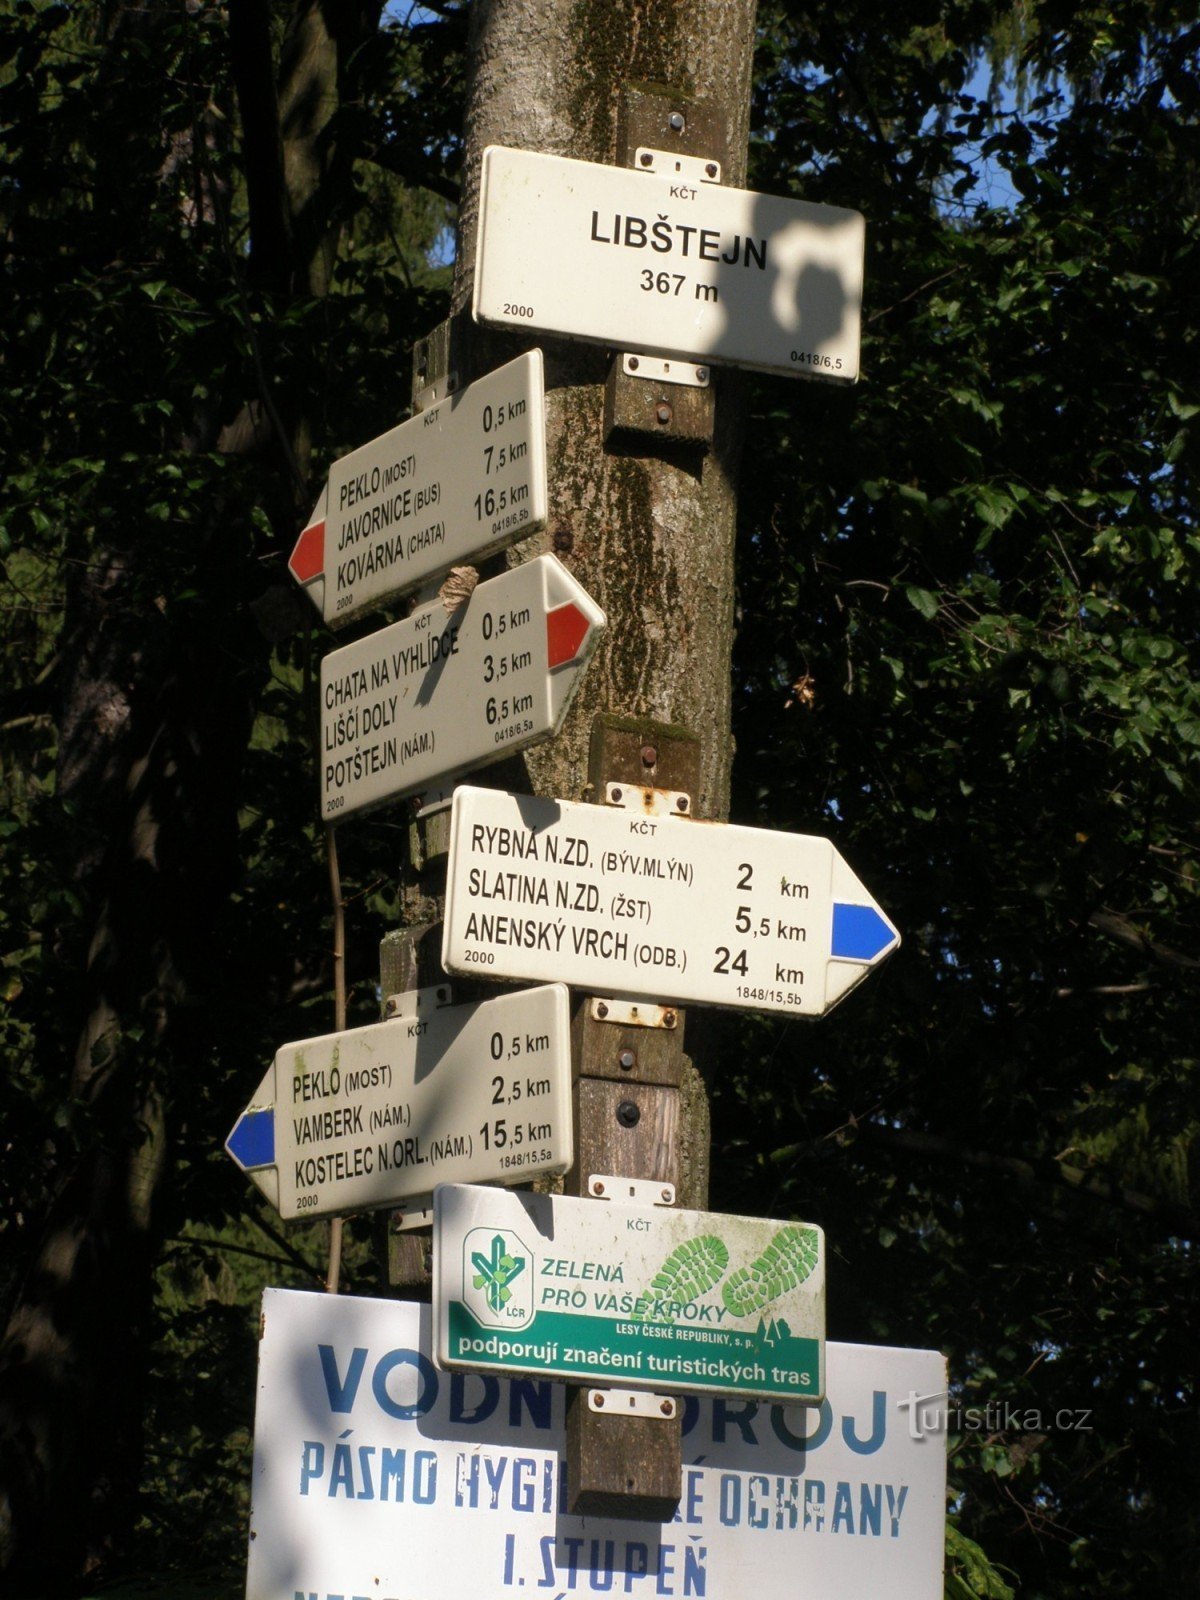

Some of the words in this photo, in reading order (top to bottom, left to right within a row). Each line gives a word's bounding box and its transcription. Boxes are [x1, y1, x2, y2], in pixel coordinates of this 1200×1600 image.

[670, 185, 697, 201] KČT
[590, 210, 767, 270] LIBŠTEJN
[640, 269, 686, 296] 367
[695, 283, 718, 302] m
[503, 303, 534, 318] 2000
[790, 350, 843, 371] 0418/6,5
[423, 409, 440, 427] KČT
[339, 467, 380, 511] PEKLO
[382, 454, 416, 493] (MOST)
[482, 405, 505, 432] 0,5
[508, 399, 526, 421] km
[338, 489, 411, 551] JAVORNICE
[414, 482, 441, 515] (BUS)
[484, 445, 506, 475] 7,5
[509, 441, 527, 463] km
[491, 507, 529, 535] 0418/6,5b
[337, 535, 404, 591] KOVÁRNA
[406, 521, 446, 561] (CHATA)
[474, 488, 507, 521] 16,5
[510, 483, 529, 505] km
[336, 594, 353, 611] 2000
[414, 614, 432, 631] KČT
[325, 667, 368, 710] CHATA
[371, 660, 390, 696] NA
[393, 626, 459, 677] VYHLÍDCE
[482, 612, 506, 640] 0,5
[510, 608, 530, 629] km
[325, 708, 359, 751] LIŠČÍ
[362, 695, 398, 737] DOLY
[483, 655, 507, 683] 3,5
[511, 651, 532, 673] km
[325, 737, 397, 792] POTŠTEJN
[400, 730, 435, 766] (NÁM.)
[486, 697, 509, 725] 6,5
[513, 694, 533, 716] km
[494, 719, 534, 743] 0418/6,5a
[326, 796, 345, 813] 2000
[629, 821, 658, 837] KČT
[471, 824, 538, 860] RYBNÁ
[544, 834, 594, 868] N.ZD.
[601, 849, 694, 887] (BÝV.MLÝN)
[736, 863, 754, 891] 2
[780, 878, 810, 899] km
[468, 868, 549, 905] SLATINA
[555, 881, 604, 915] N.ZD.
[610, 894, 652, 925] (ŽST)
[735, 906, 770, 939] 5,5
[777, 920, 806, 942] km
[464, 912, 565, 952] ANENSKÝ
[572, 926, 628, 961] VRCH
[633, 944, 687, 974] (ODB.)
[713, 946, 749, 977] 24
[775, 963, 805, 985] km
[464, 950, 495, 965] 2000
[736, 986, 802, 1006] 1848/15,5b
[407, 1022, 429, 1038] KČT
[293, 1068, 341, 1103] PEKLO
[345, 1064, 392, 1096] (MOST)
[490, 1032, 521, 1061] 0,5
[526, 1034, 549, 1054] km
[293, 1105, 363, 1145] VAMBERK
[369, 1103, 411, 1135] (NÁM.)
[491, 1076, 521, 1105] 2,5
[527, 1078, 551, 1098] km
[295, 1147, 374, 1188] KOSTELEC
[480, 1119, 523, 1150] 15,5
[528, 1122, 552, 1142] km
[499, 1149, 552, 1168] 1848/15,5a
[296, 1194, 319, 1209] 2000
[626, 1218, 652, 1233] KČT
[541, 1257, 625, 1284] ZELENÁ
[541, 1287, 587, 1308] PRO
[595, 1290, 647, 1316] VAŠE
[652, 1299, 728, 1323] KROKY
[616, 1323, 639, 1336] LESY
[642, 1322, 673, 1339] ČESKÉ
[675, 1329, 733, 1347] REPUBLIKY,
[734, 1337, 743, 1347] s.
[745, 1339, 754, 1348] p.
[458, 1335, 558, 1361] podporují
[563, 1344, 642, 1370] značení
[647, 1351, 766, 1383] turistických
[771, 1363, 811, 1386] tras
[300, 1429, 438, 1505] PÁSMO
[719, 1474, 909, 1538] OCHRANY
[503, 1533, 525, 1586] I.
[537, 1535, 707, 1597] STUPEŇ
